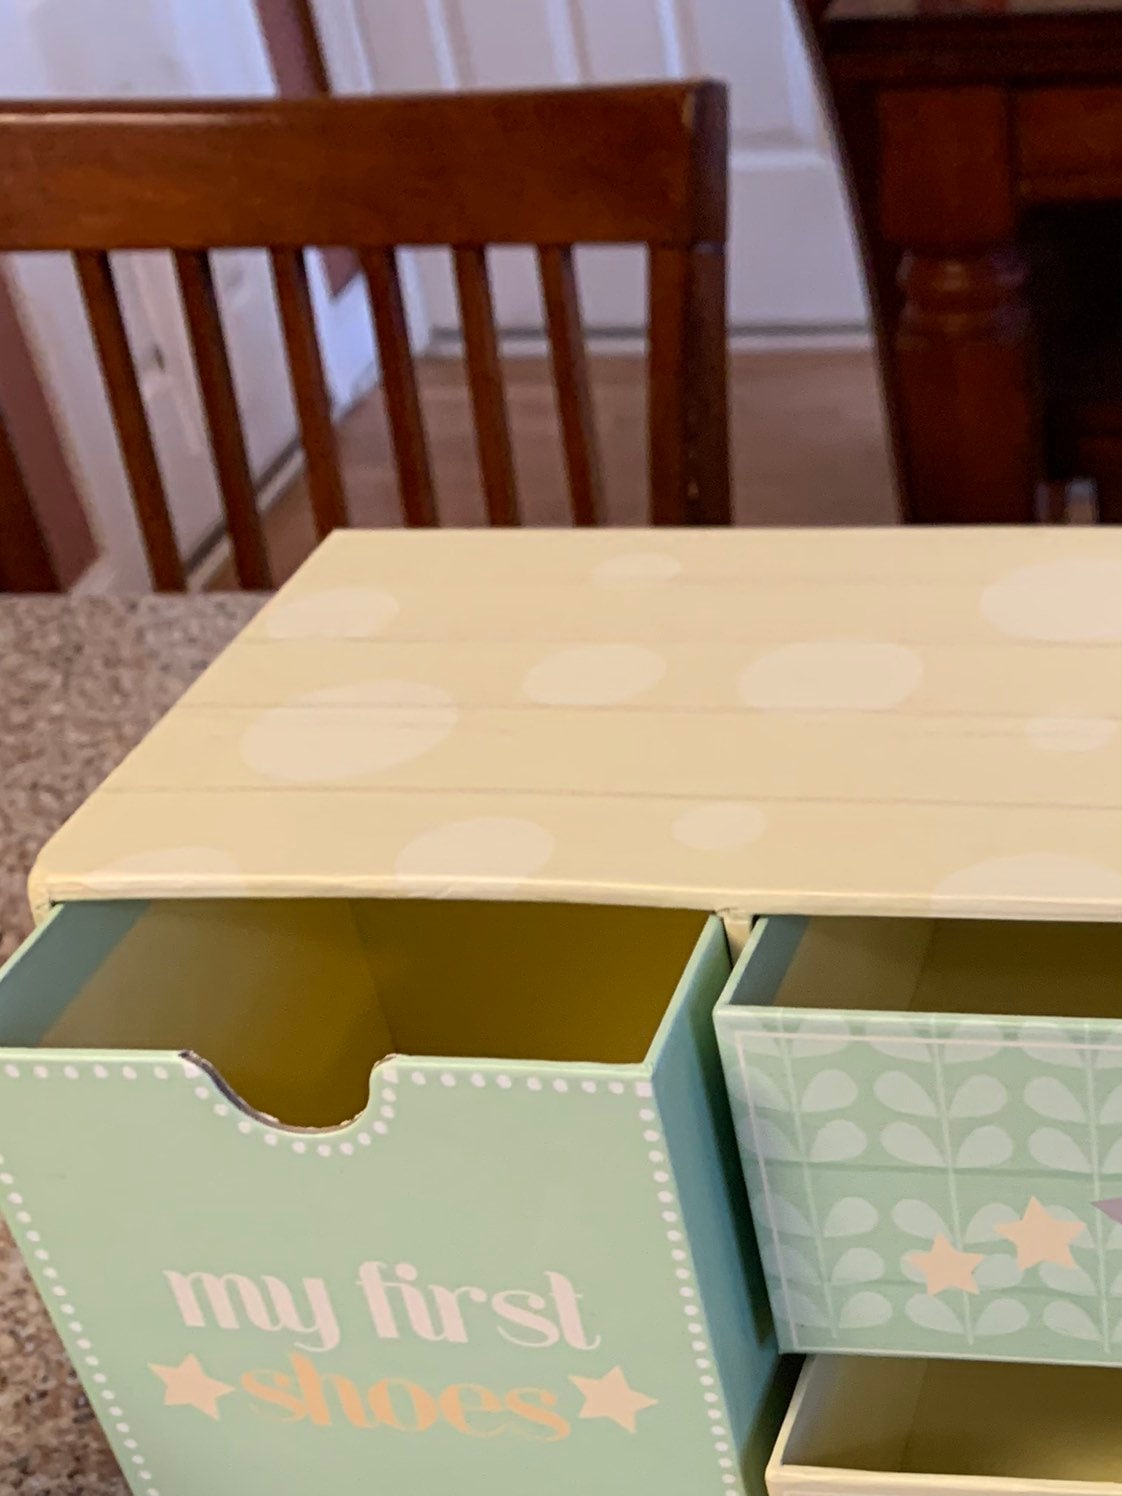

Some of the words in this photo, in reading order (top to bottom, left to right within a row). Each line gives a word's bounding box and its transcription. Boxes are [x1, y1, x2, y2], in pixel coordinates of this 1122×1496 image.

[162, 1268, 341, 1352] my
[356, 1261, 600, 1350] first
[241, 1354, 571, 1443] shoes
